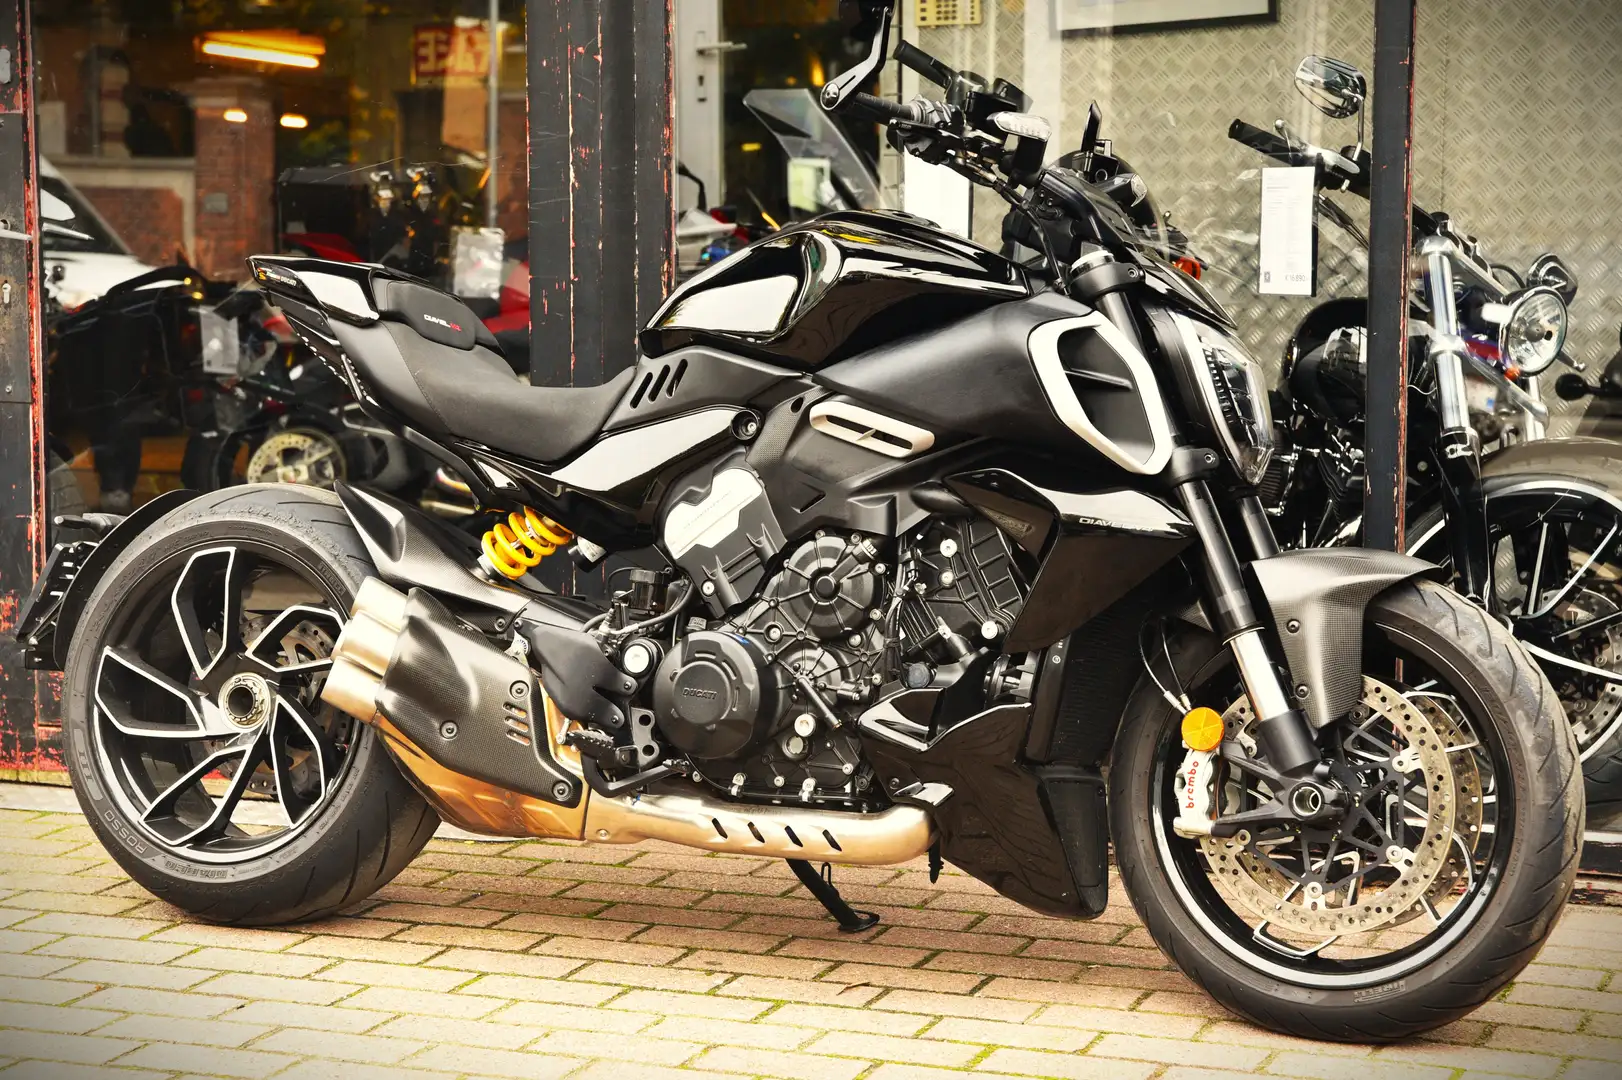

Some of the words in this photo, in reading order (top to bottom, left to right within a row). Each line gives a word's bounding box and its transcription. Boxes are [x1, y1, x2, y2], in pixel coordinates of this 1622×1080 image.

[682, 687, 718, 700] DUCATI
[1185, 760, 1200, 809] brembo
[104, 810, 148, 854] ROSSO
[1353, 979, 1407, 1003] PIRELLI
